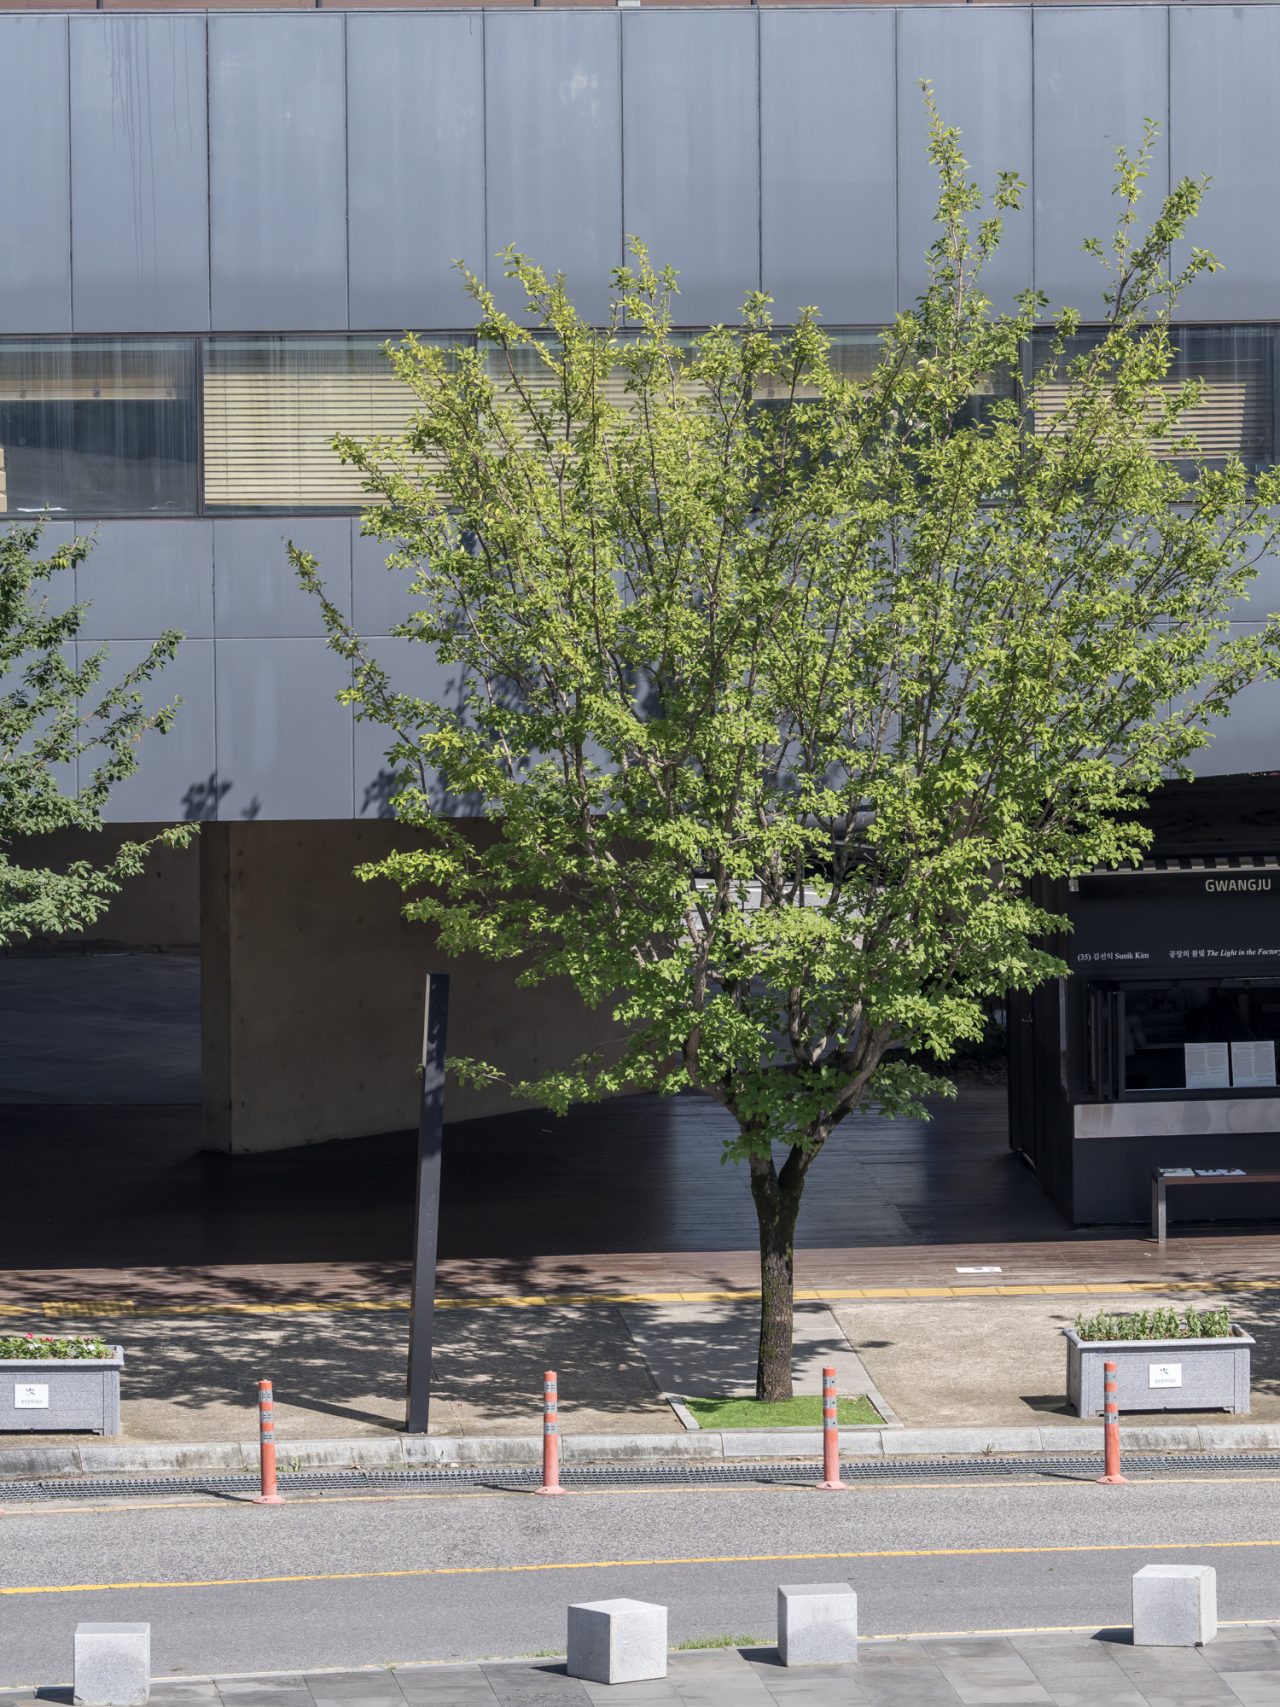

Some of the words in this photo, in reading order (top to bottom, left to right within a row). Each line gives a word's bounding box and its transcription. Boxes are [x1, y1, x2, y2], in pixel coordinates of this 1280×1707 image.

[1205, 879, 1272, 892] GWANGJU
[1077, 953, 1092, 962] (35)
[1135, 951, 1150, 960] Kim
[1207, 949, 1219, 957] The
[1220, 948, 1238, 958] Light
[1246, 948, 1256, 956] the
